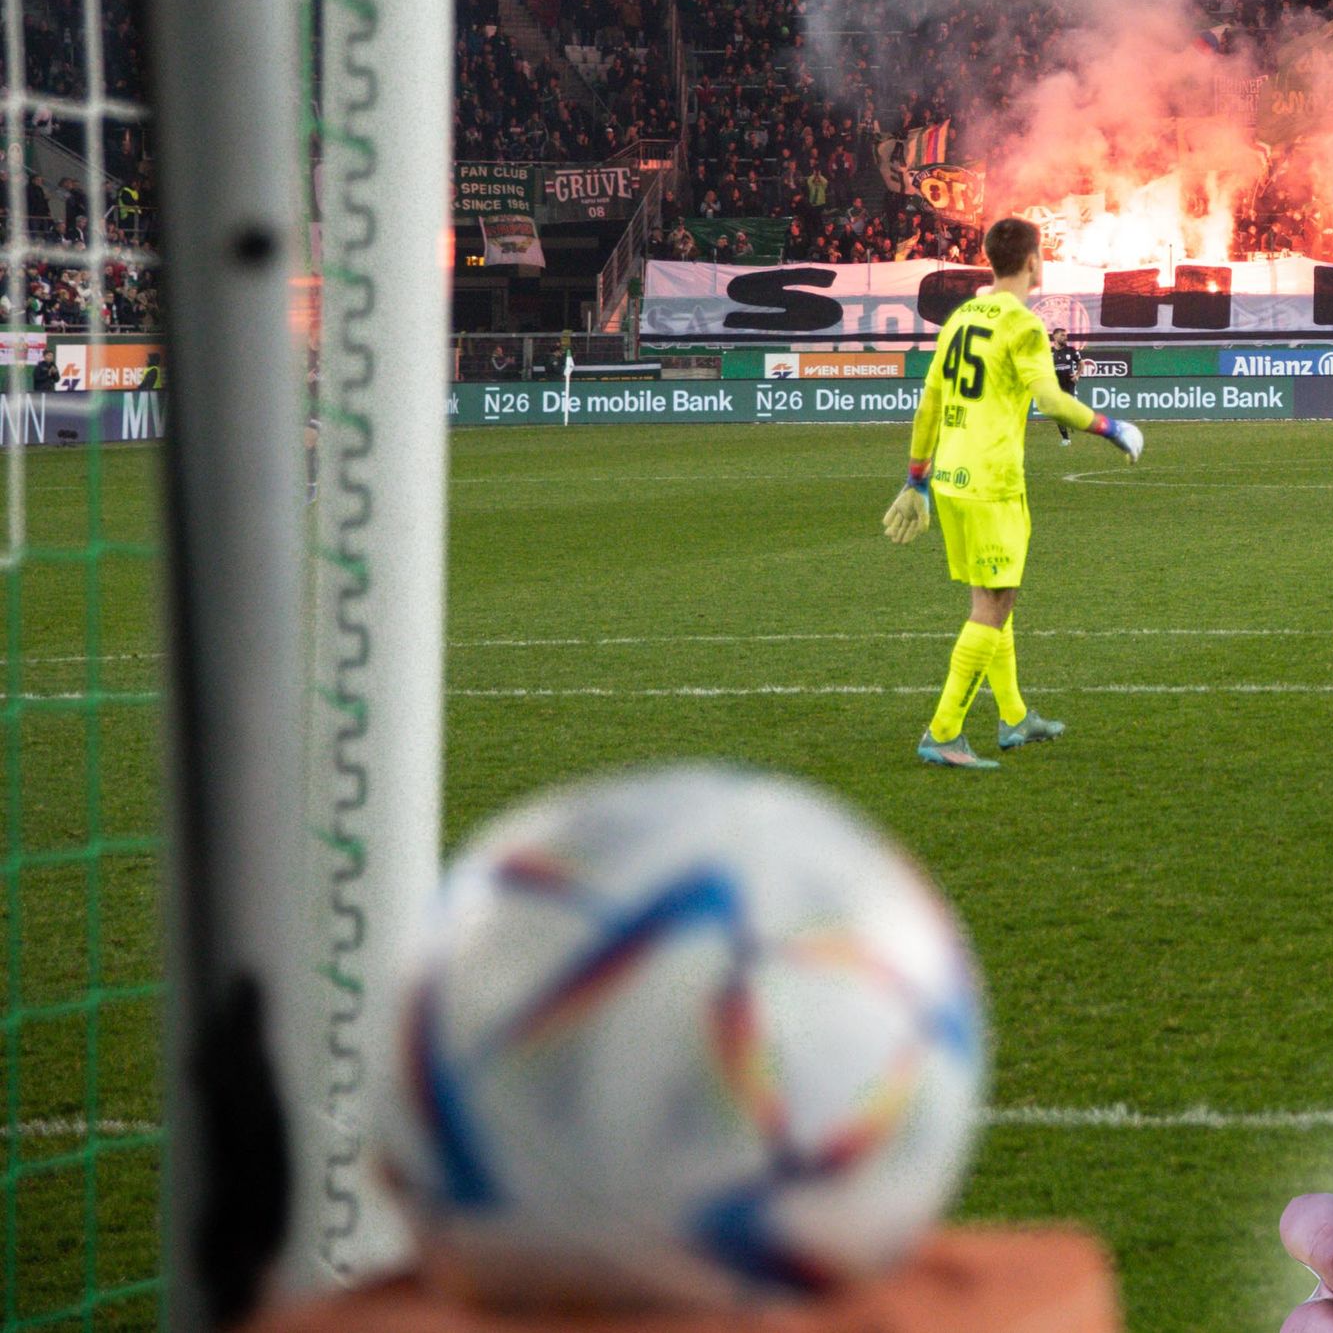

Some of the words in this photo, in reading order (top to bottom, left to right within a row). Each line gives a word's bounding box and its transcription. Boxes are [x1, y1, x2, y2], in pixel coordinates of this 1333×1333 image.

[460, 166, 488, 177] FAN
[493, 167, 528, 180] CLUB
[461, 183, 525, 197] SPEISING
[555, 167, 633, 202] GRÜVE
[462, 199, 502, 210] SINCE
[804, 364, 839, 376] WIEN
[843, 364, 898, 376] ENERGIE
[943, 324, 994, 400] 45
[1232, 356, 1314, 376] Allianz
[90, 368, 119, 387] WIEN
[485, 390, 529, 417] N26
[542, 390, 582, 412] Die
[587, 389, 667, 412] mobile
[673, 389, 733, 412] Bank
[757, 386, 802, 414] N26
[816, 389, 855, 410] Die
[1092, 386, 1131, 409] Die
[1137, 386, 1216, 409] mobile
[1223, 385, 1283, 408] Bank
